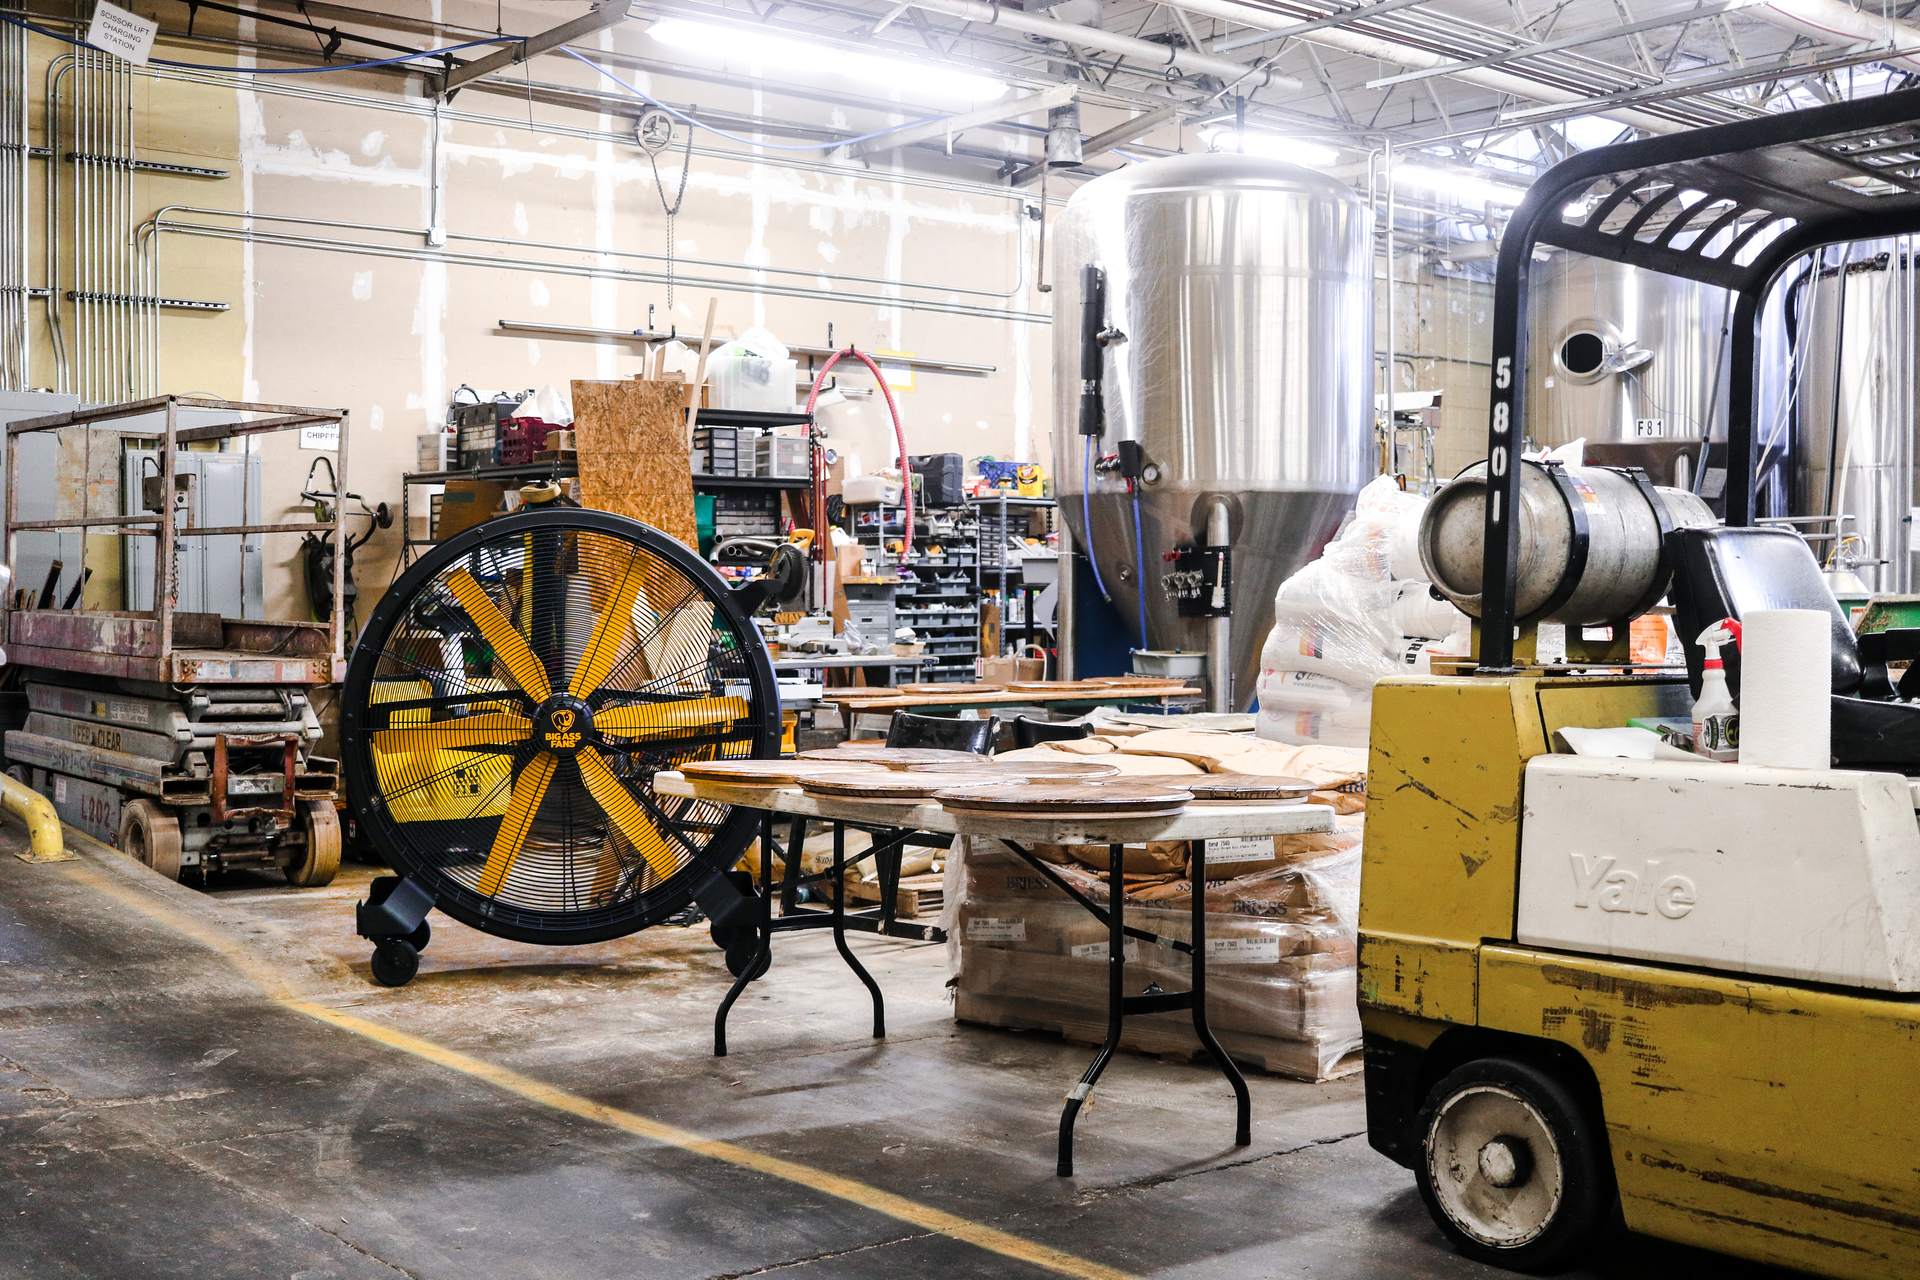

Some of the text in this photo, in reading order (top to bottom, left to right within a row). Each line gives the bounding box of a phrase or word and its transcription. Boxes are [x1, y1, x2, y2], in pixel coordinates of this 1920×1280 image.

[100, 10, 150, 36] SCISSOR LIFT
[102, 21, 142, 43] CHARGING
[103, 33, 135, 51] STATION
[97, 729, 122, 752] CLEAR
[545, 732, 582, 741] BIG ASS
[550, 740, 577, 748] FANS
[81, 793, 111, 829] L202
[1006, 876, 1050, 890] BRIESS
[1570, 853, 1697, 920] Yale
